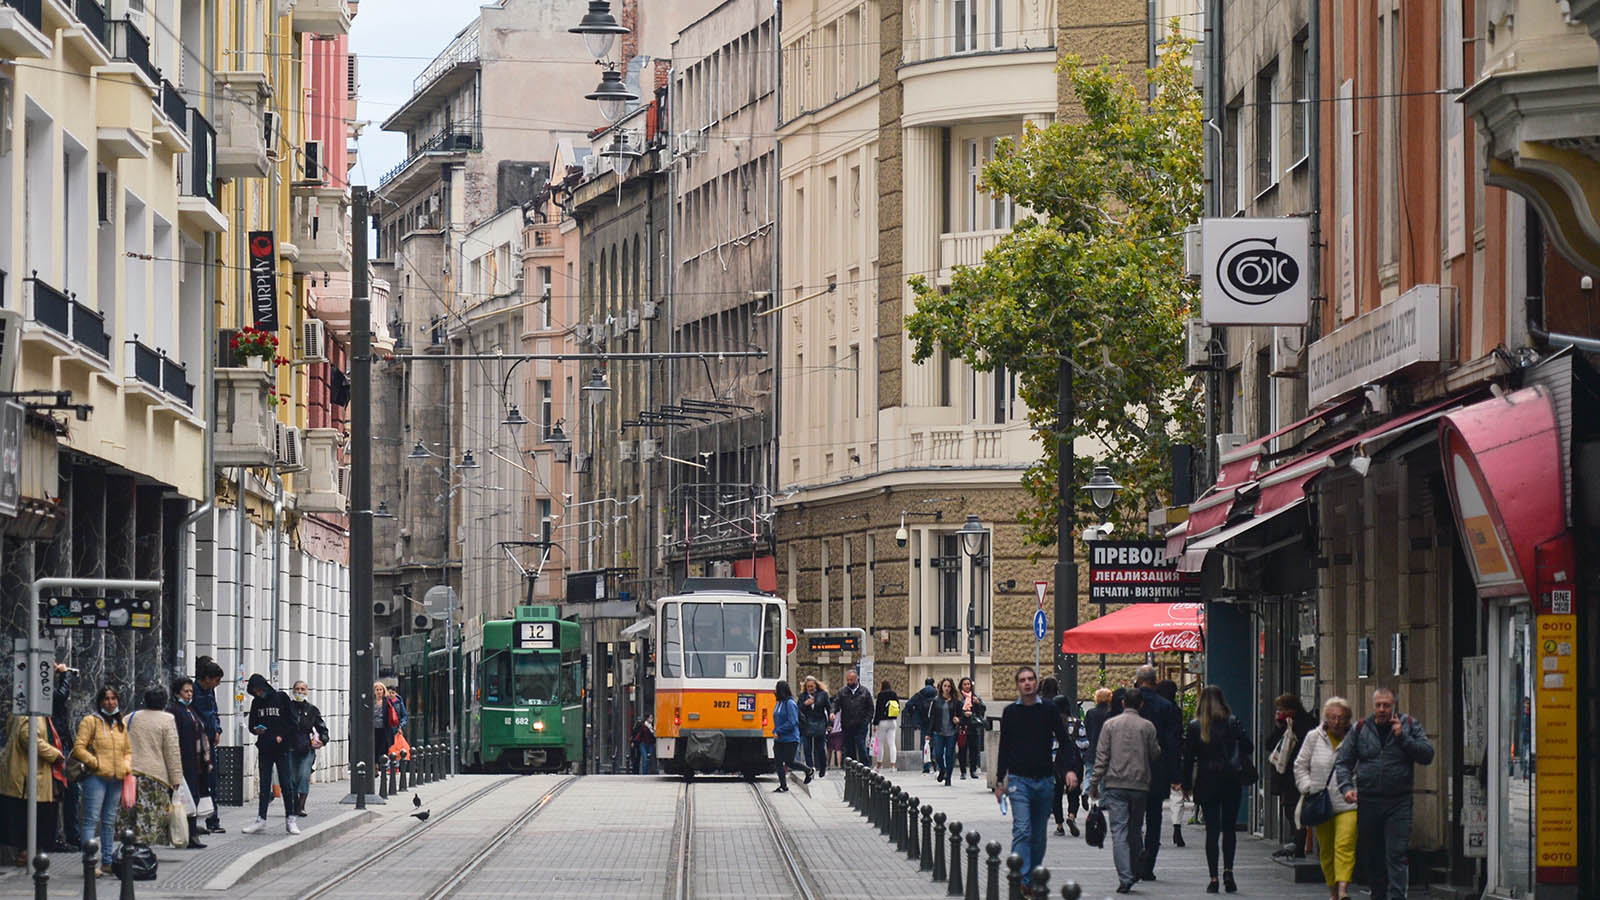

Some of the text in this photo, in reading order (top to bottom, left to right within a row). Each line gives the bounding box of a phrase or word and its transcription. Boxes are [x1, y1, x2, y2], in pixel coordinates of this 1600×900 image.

[255, 257, 272, 322] MURPHY
[1095, 571, 1180, 582] ЛЕГАЛИЗАЦИЯ
[1093, 586, 1129, 597] ПЕЧАТИ
[1135, 586, 1180, 597] ВИЗИТКИ
[529, 625, 544, 639] 12
[1542, 622, 1572, 631] ФОТО
[733, 662, 743, 673] 10
[515, 717, 529, 725] 682
